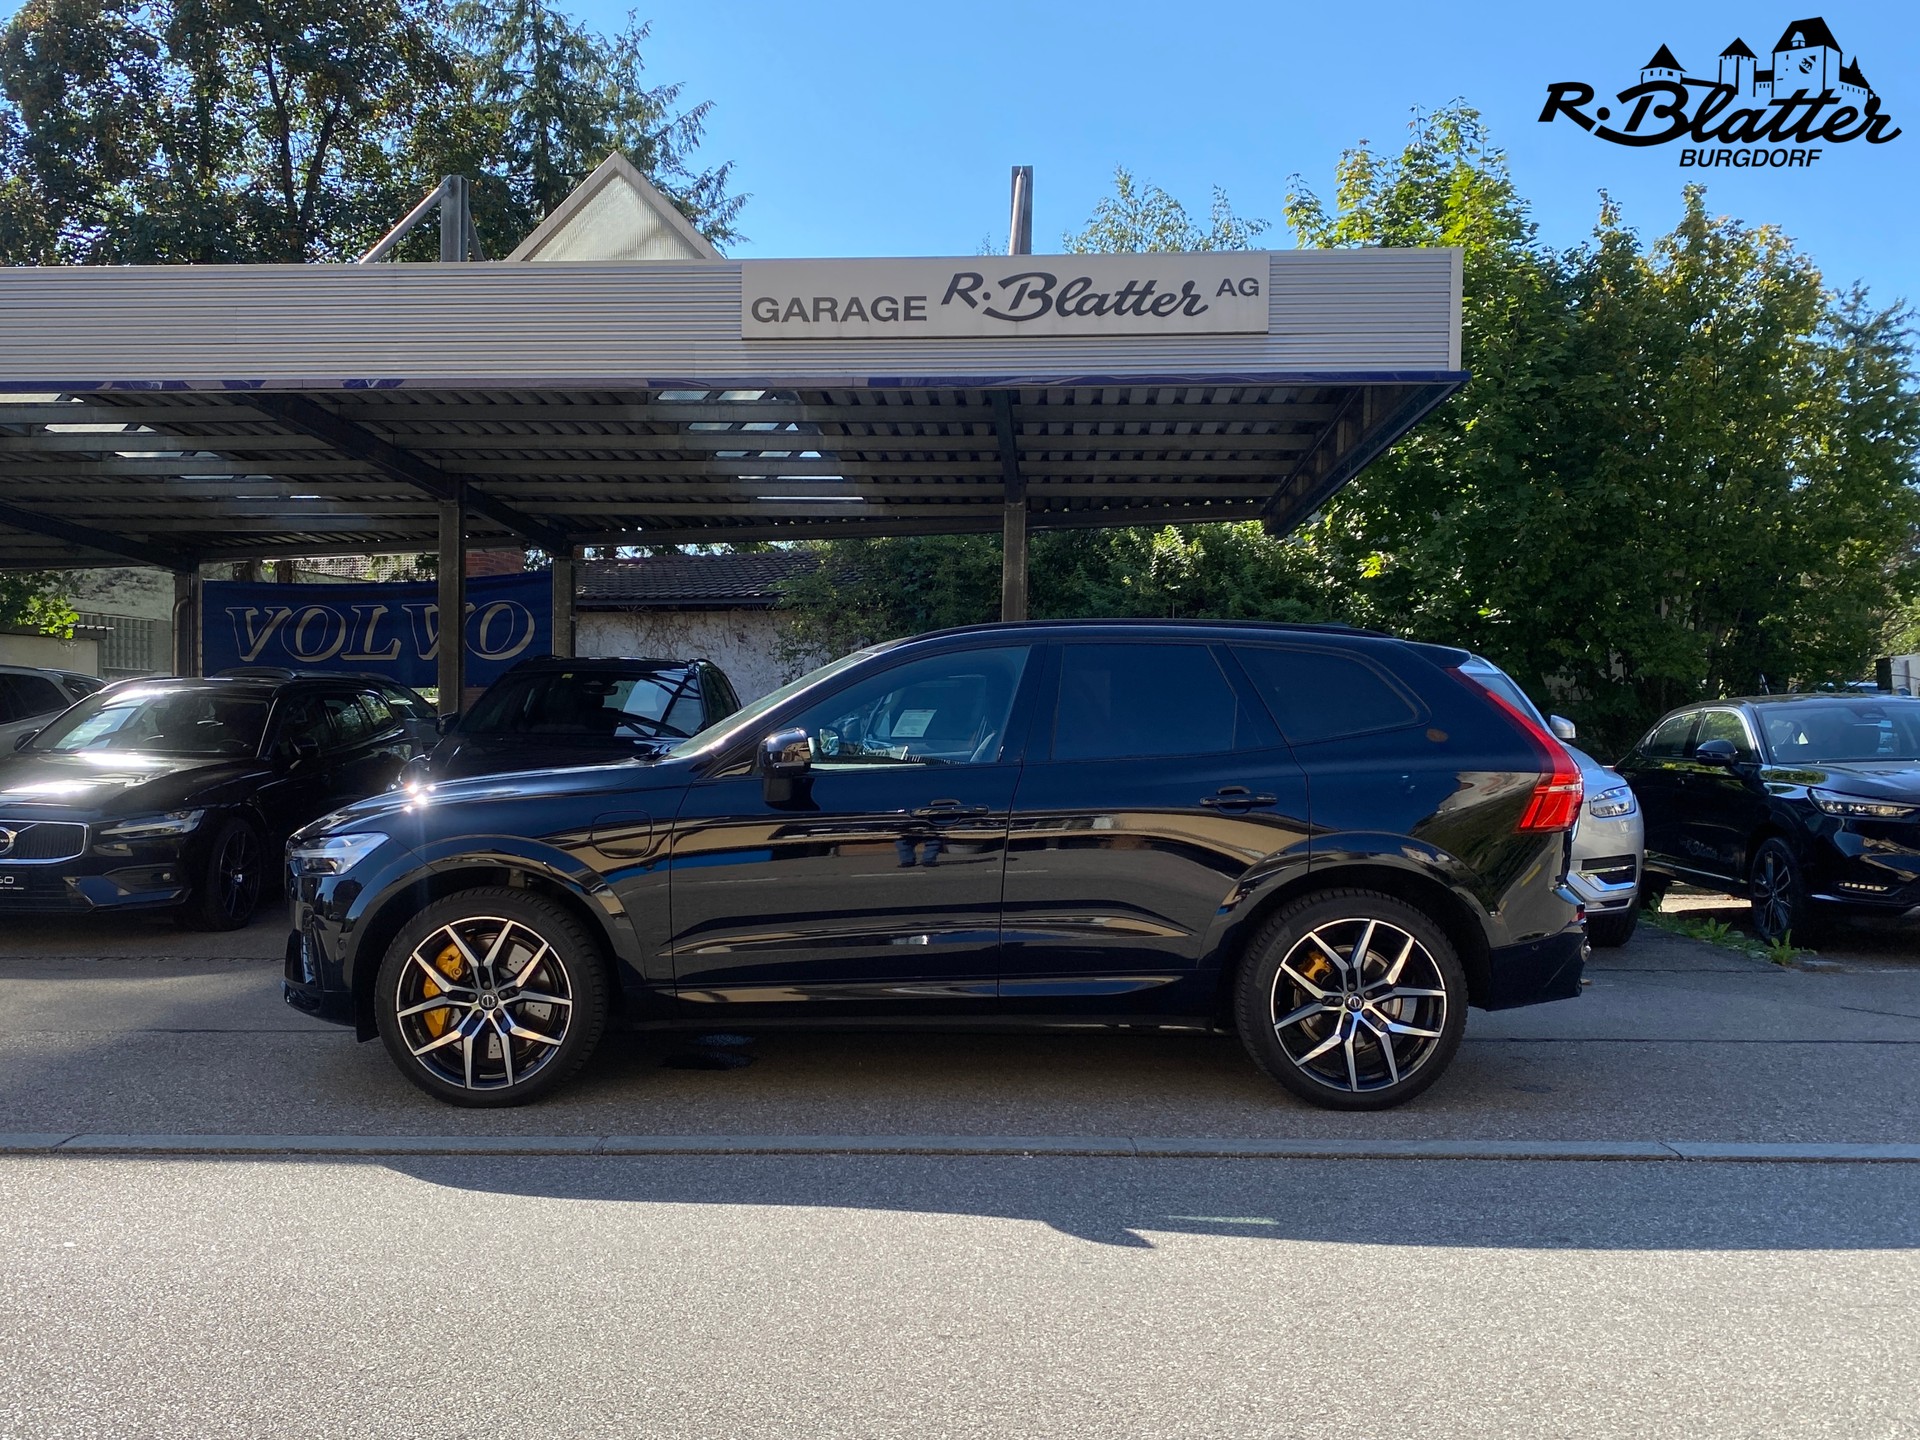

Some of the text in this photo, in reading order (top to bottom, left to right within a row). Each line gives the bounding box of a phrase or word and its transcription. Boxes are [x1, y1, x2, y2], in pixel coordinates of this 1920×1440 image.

[751, 295, 928, 324] GARAGE
[1216, 277, 1260, 298] AG
[225, 600, 536, 662] VOLVO
